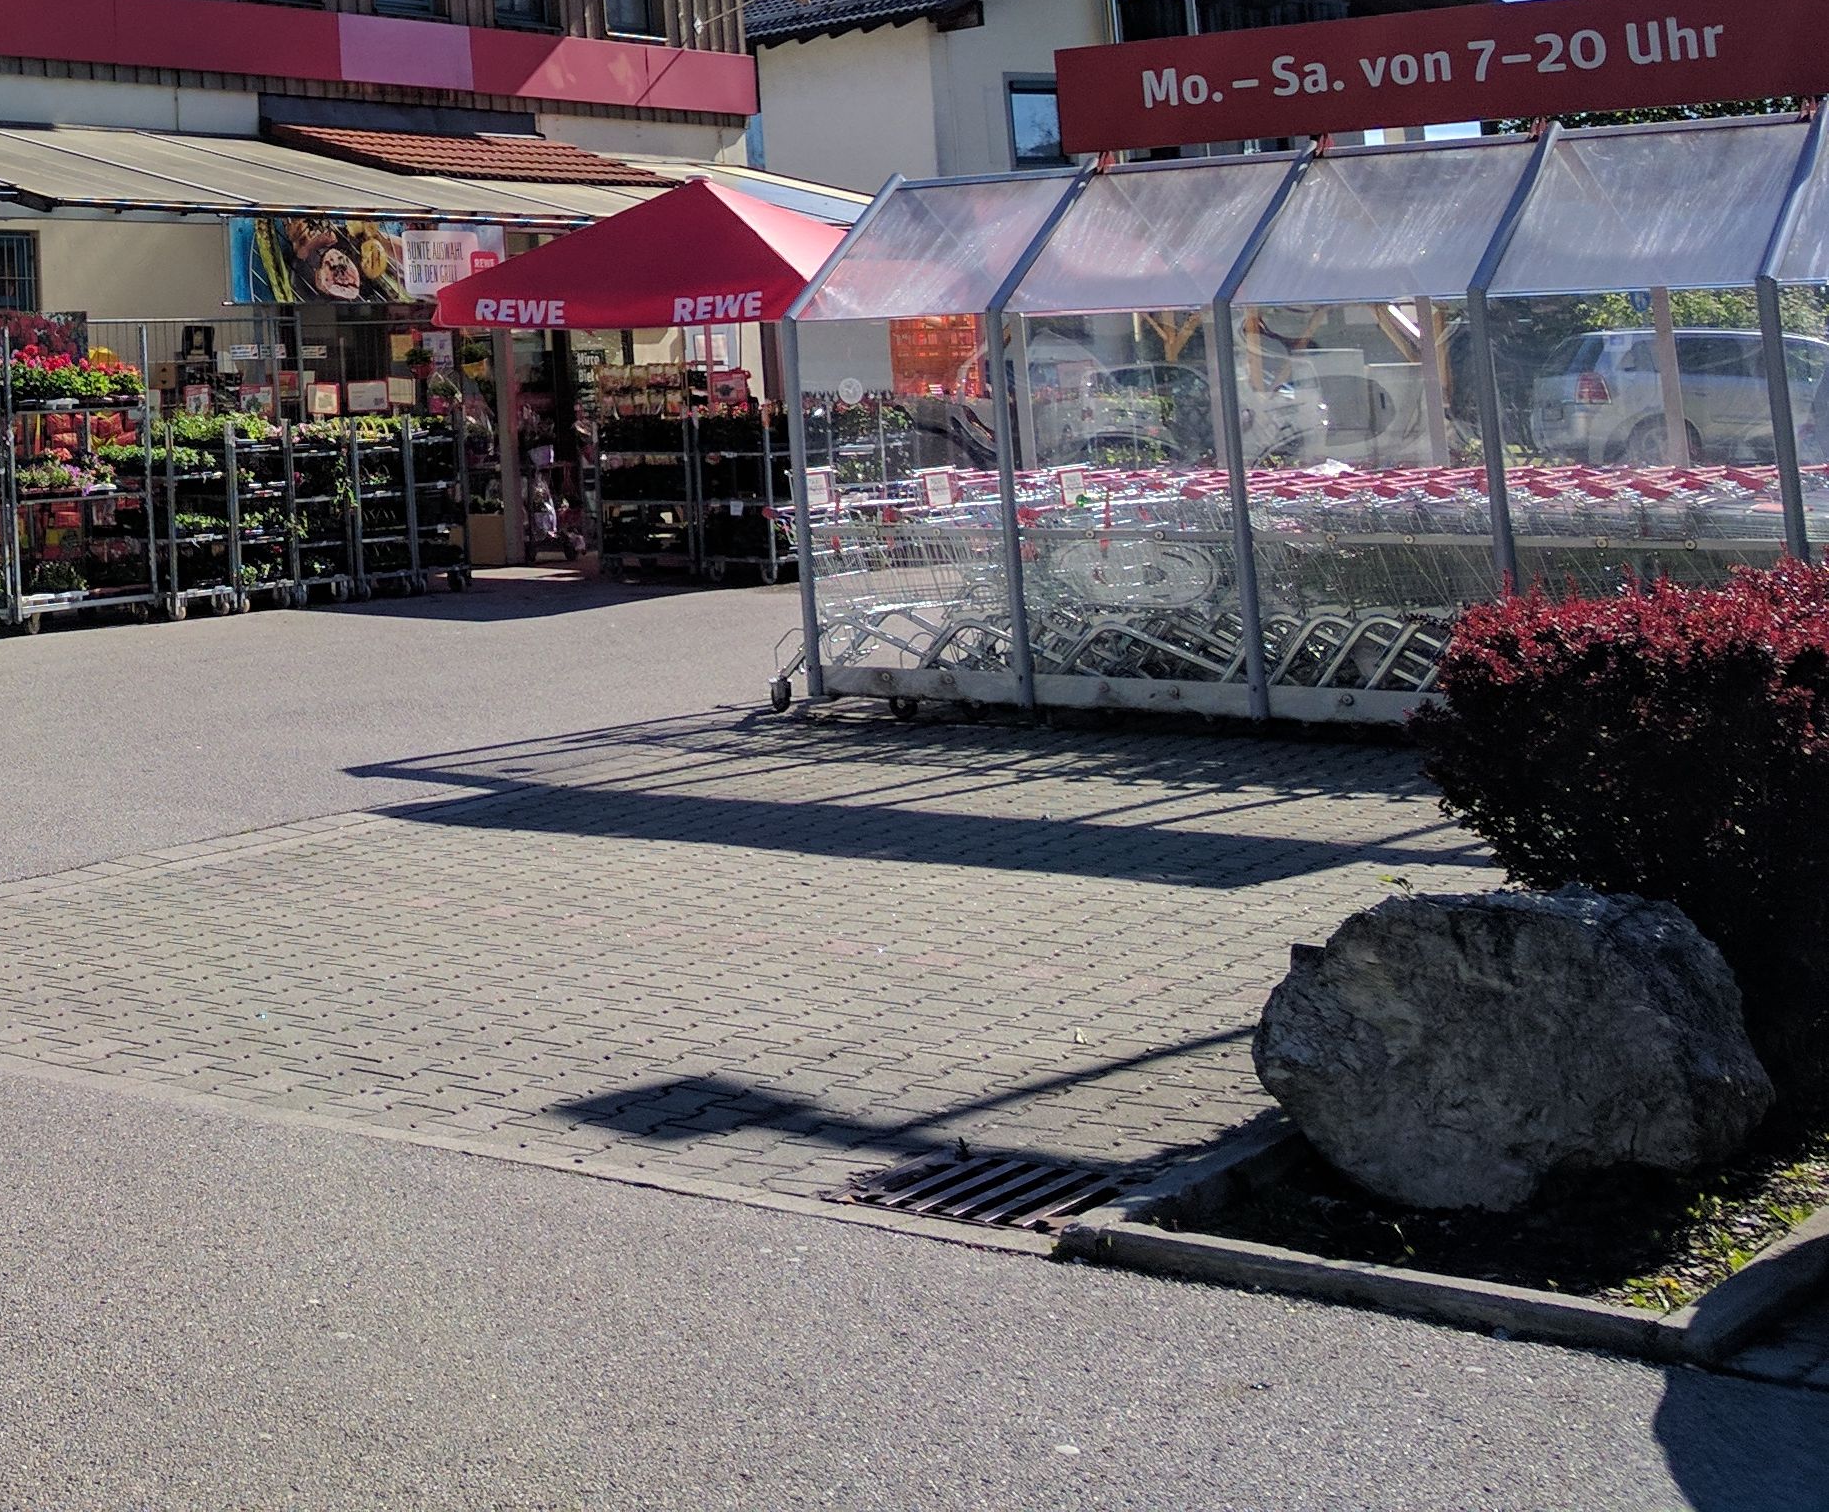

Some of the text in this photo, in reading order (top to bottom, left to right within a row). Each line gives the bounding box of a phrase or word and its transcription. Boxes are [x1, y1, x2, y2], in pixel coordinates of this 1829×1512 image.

[1271, 55, 1345, 96] Sa.
[1359, 49, 1452, 88] von
[1626, 16, 1724, 65] Uhr
[407, 241, 464, 260] BUNTE AUSWAHL
[408, 261, 423, 283] FÜR
[425, 265, 438, 283] DEN
[474, 258, 495, 268] REWE
[475, 299, 565, 324] REWE
[673, 292, 763, 322] REWE
[577, 352, 600, 366] Mirco
